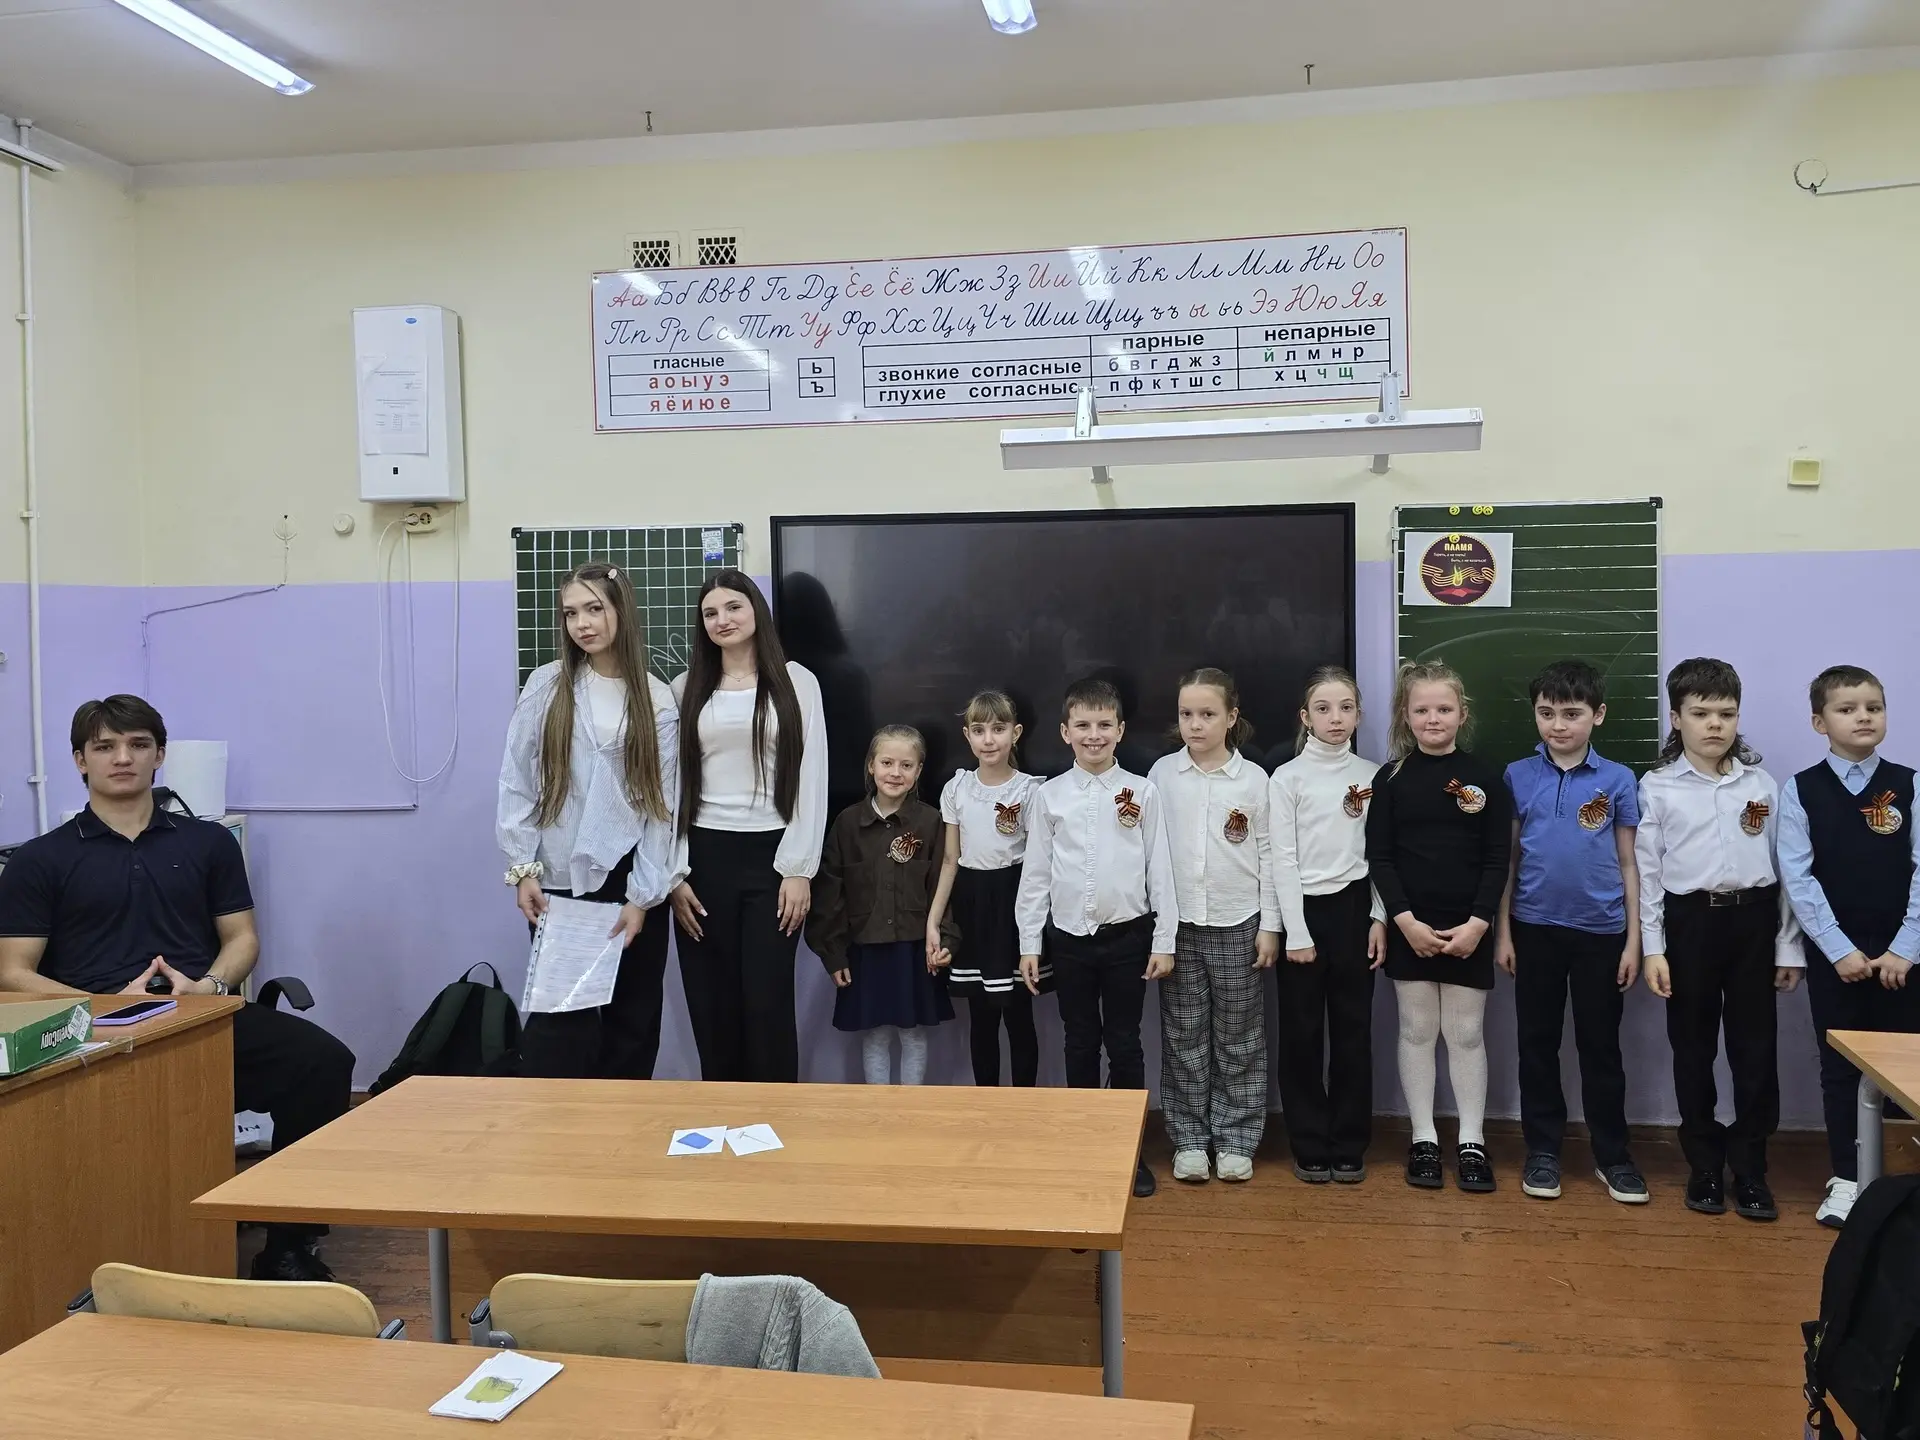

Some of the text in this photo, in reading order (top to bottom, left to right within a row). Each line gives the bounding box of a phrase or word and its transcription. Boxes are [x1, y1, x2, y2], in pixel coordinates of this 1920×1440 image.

[1264, 322, 1376, 342] непарные
[1122, 333, 1204, 351] парные
[653, 356, 724, 370] гласные
[879, 361, 1081, 381] звонкие согласные
[879, 382, 1078, 404] глухие согласные
[1444, 543, 1473, 551] ПЛАМЯ
